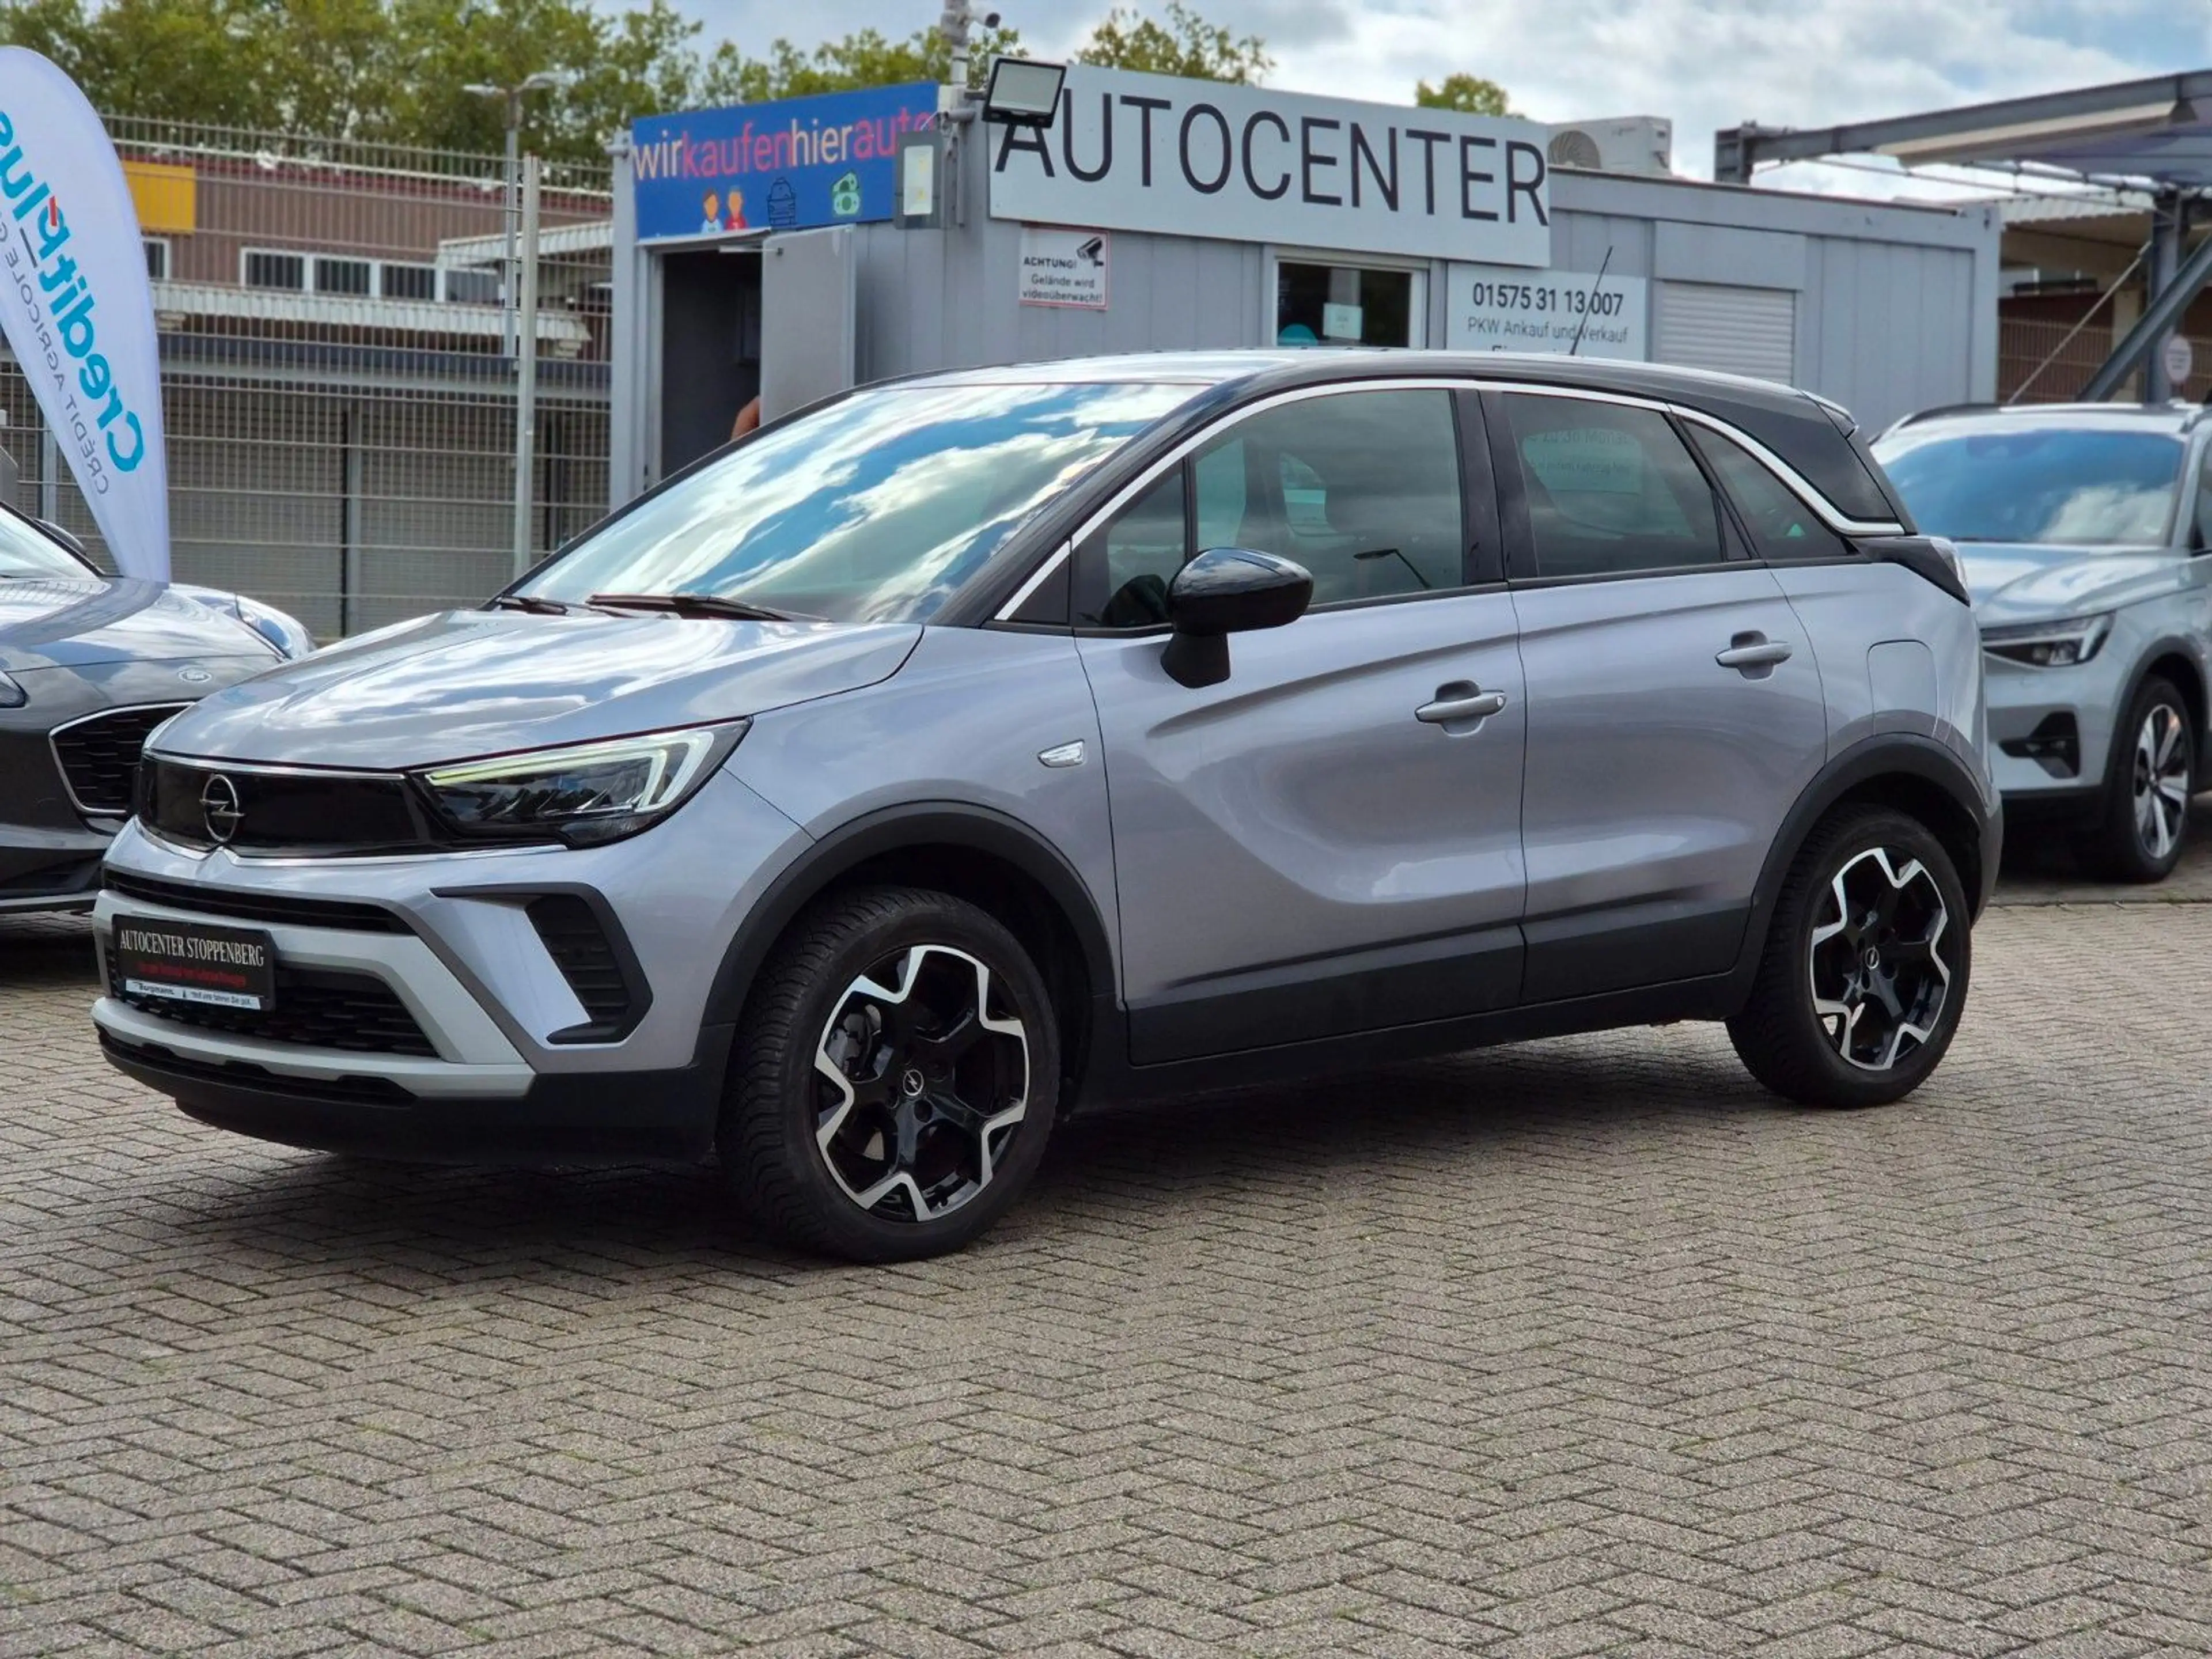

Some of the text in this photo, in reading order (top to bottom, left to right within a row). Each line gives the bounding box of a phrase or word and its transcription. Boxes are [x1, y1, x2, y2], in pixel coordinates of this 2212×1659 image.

[995, 88, 1548, 226] AUTOCENTER
[1023, 257, 1077, 269] ACHTUNG!
[1031, 273, 1094, 289] Gelände wird
[1473, 282, 1624, 316] 01575 31 13 007
[1468, 317, 1500, 333] PKW
[1504, 320, 1550, 338] Ankauf
[1552, 324, 1578, 341] und
[120, 930, 264, 967] AUTOCENTER STOPPENBERG
